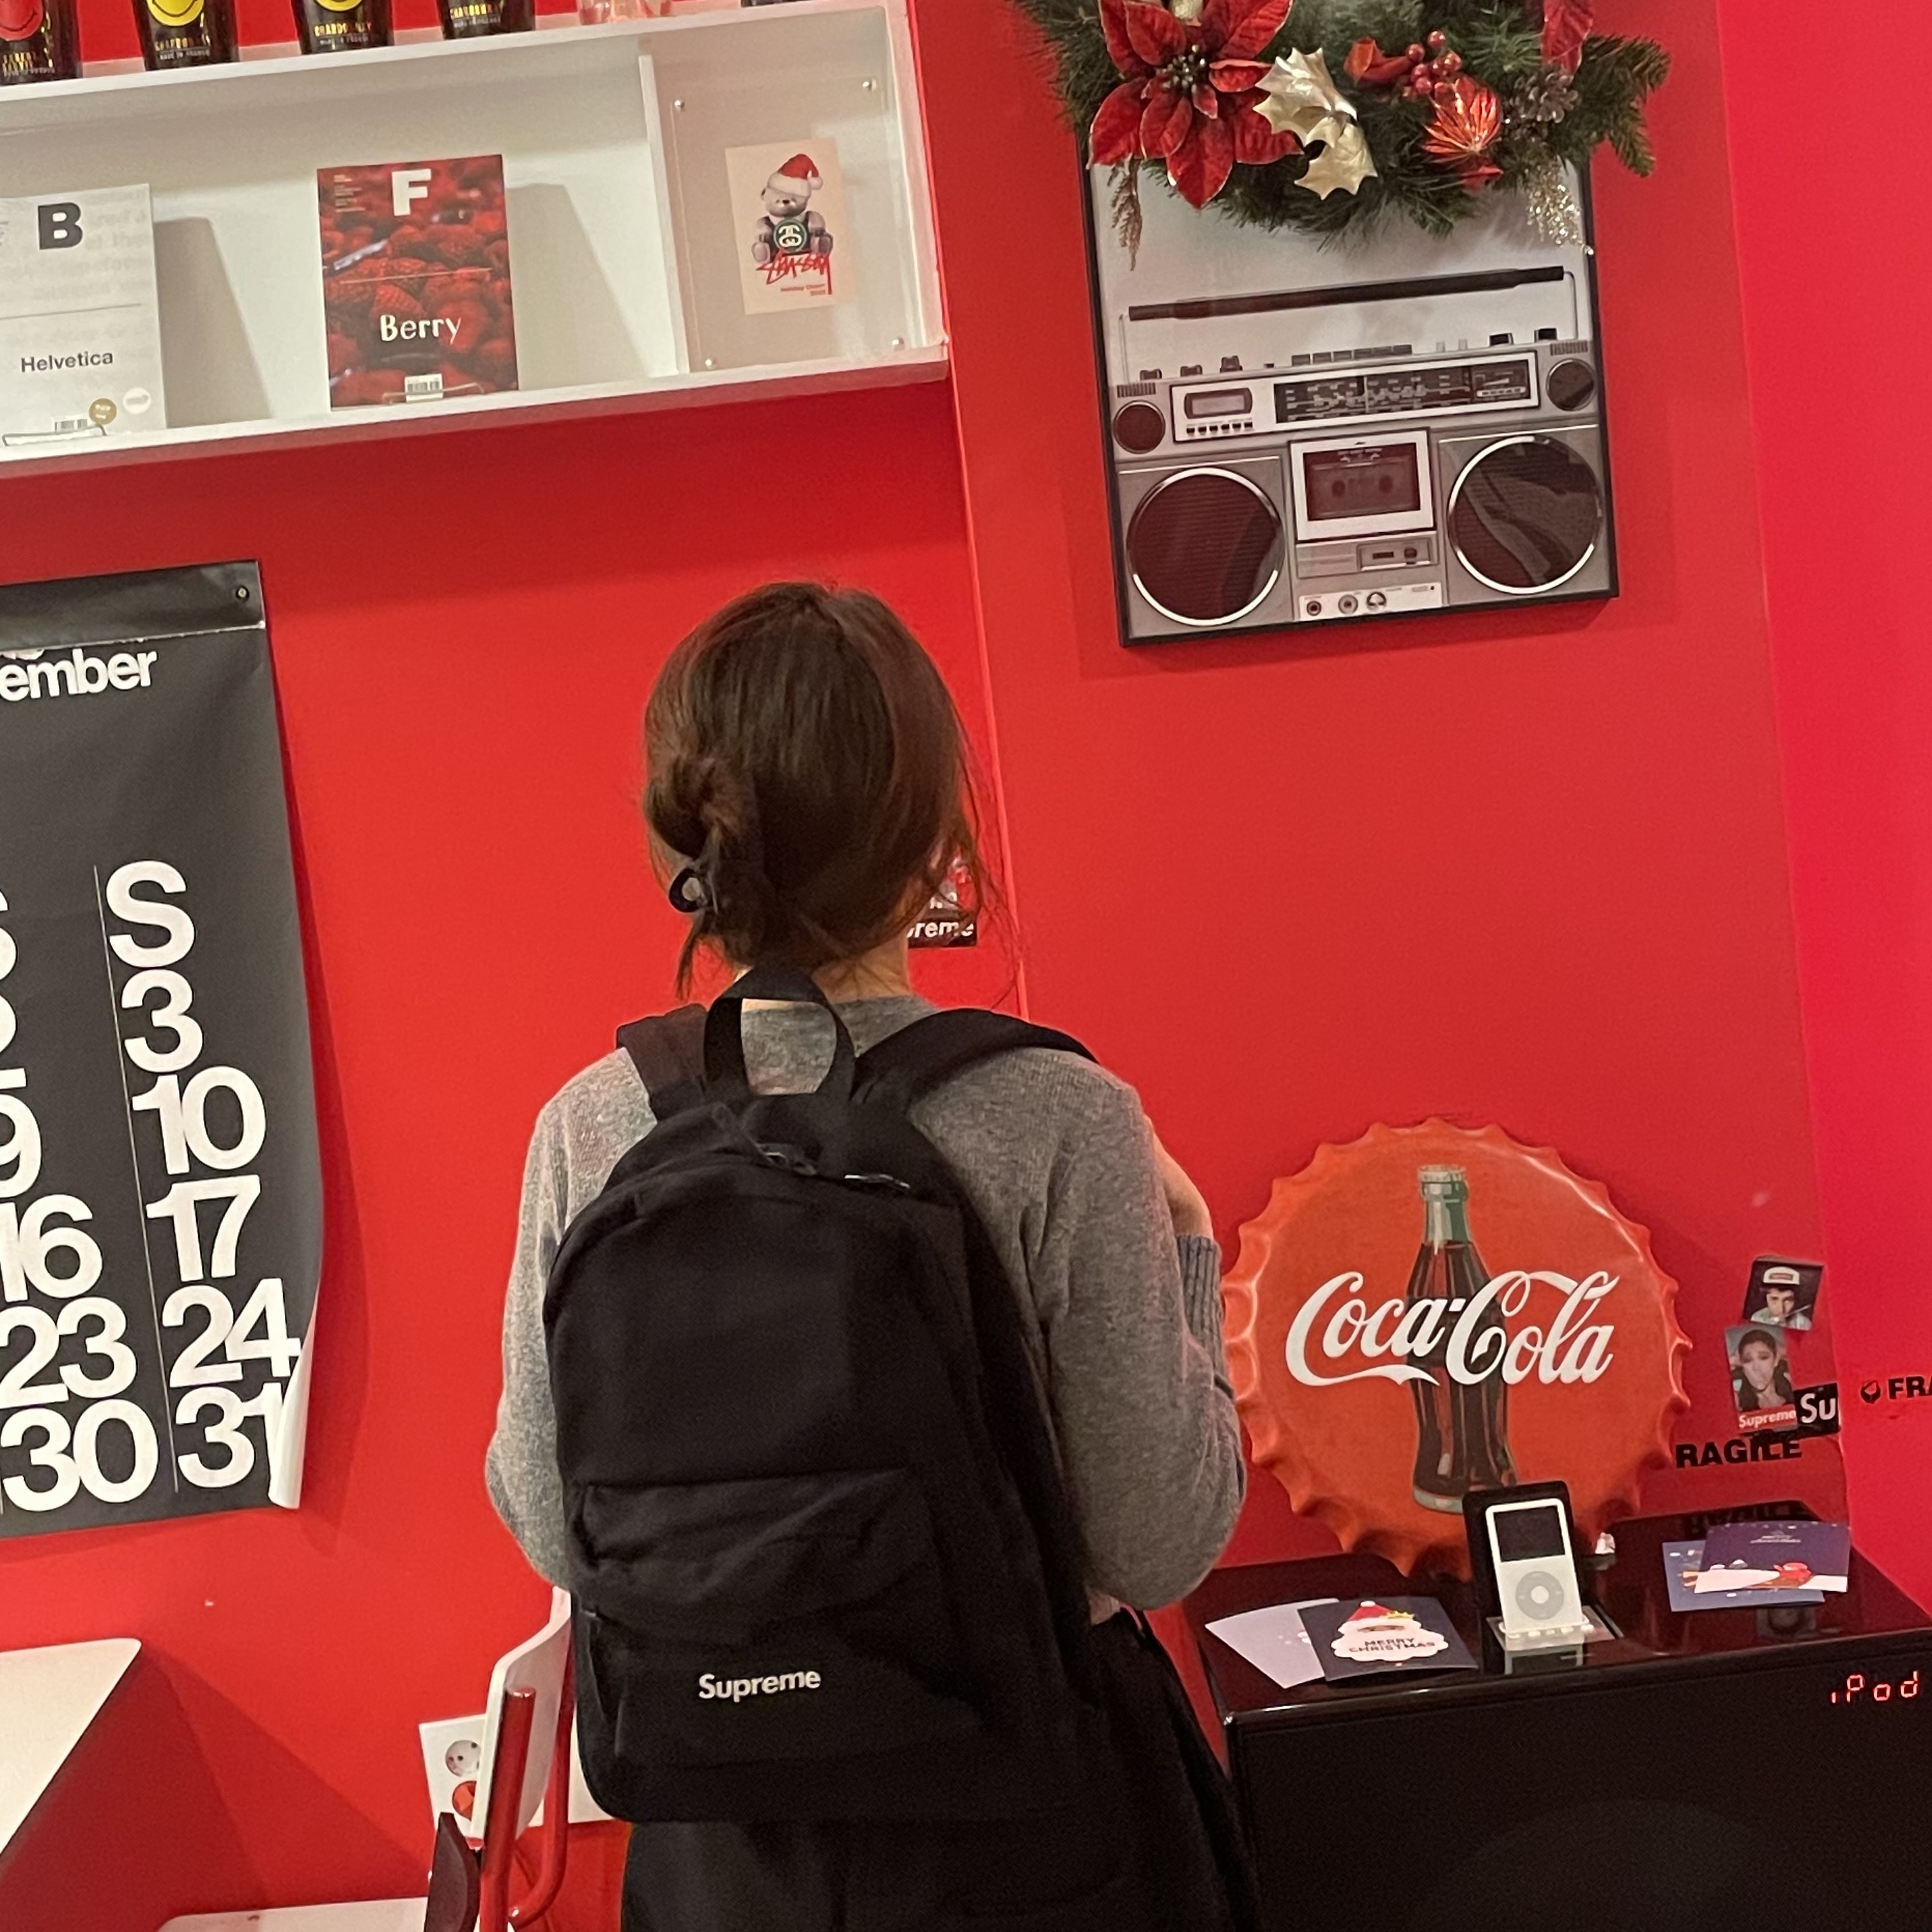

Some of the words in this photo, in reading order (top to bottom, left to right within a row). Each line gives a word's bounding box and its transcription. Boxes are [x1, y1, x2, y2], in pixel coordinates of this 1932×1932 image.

[392, 169, 432, 217] F
[38, 202, 84, 250] B
[380, 314, 462, 346] Berry
[20, 351, 114, 372] Helvetica
[106, 860, 195, 968] S
[907, 922, 974, 938] reme
[121, 969, 203, 1072] 3
[132, 1066, 266, 1174] 10
[0, 1194, 102, 1302] 16
[146, 1175, 261, 1282] 17
[0, 1297, 137, 1407] 23
[162, 1278, 302, 1387] 24
[1285, 1270, 1620, 1386] Coca-Cola
[1800, 1393, 1836, 1423] Su
[1888, 1376, 1932, 1400] FR
[1739, 1409, 1797, 1429] Supreme
[0, 1399, 158, 1511] 30
[176, 1382, 283, 1499] 31
[1349, 1641, 1436, 1652] CHRISTMAS
[1364, 1637, 1414, 1646] MERRY
[699, 1671, 821, 1703] Supreme
